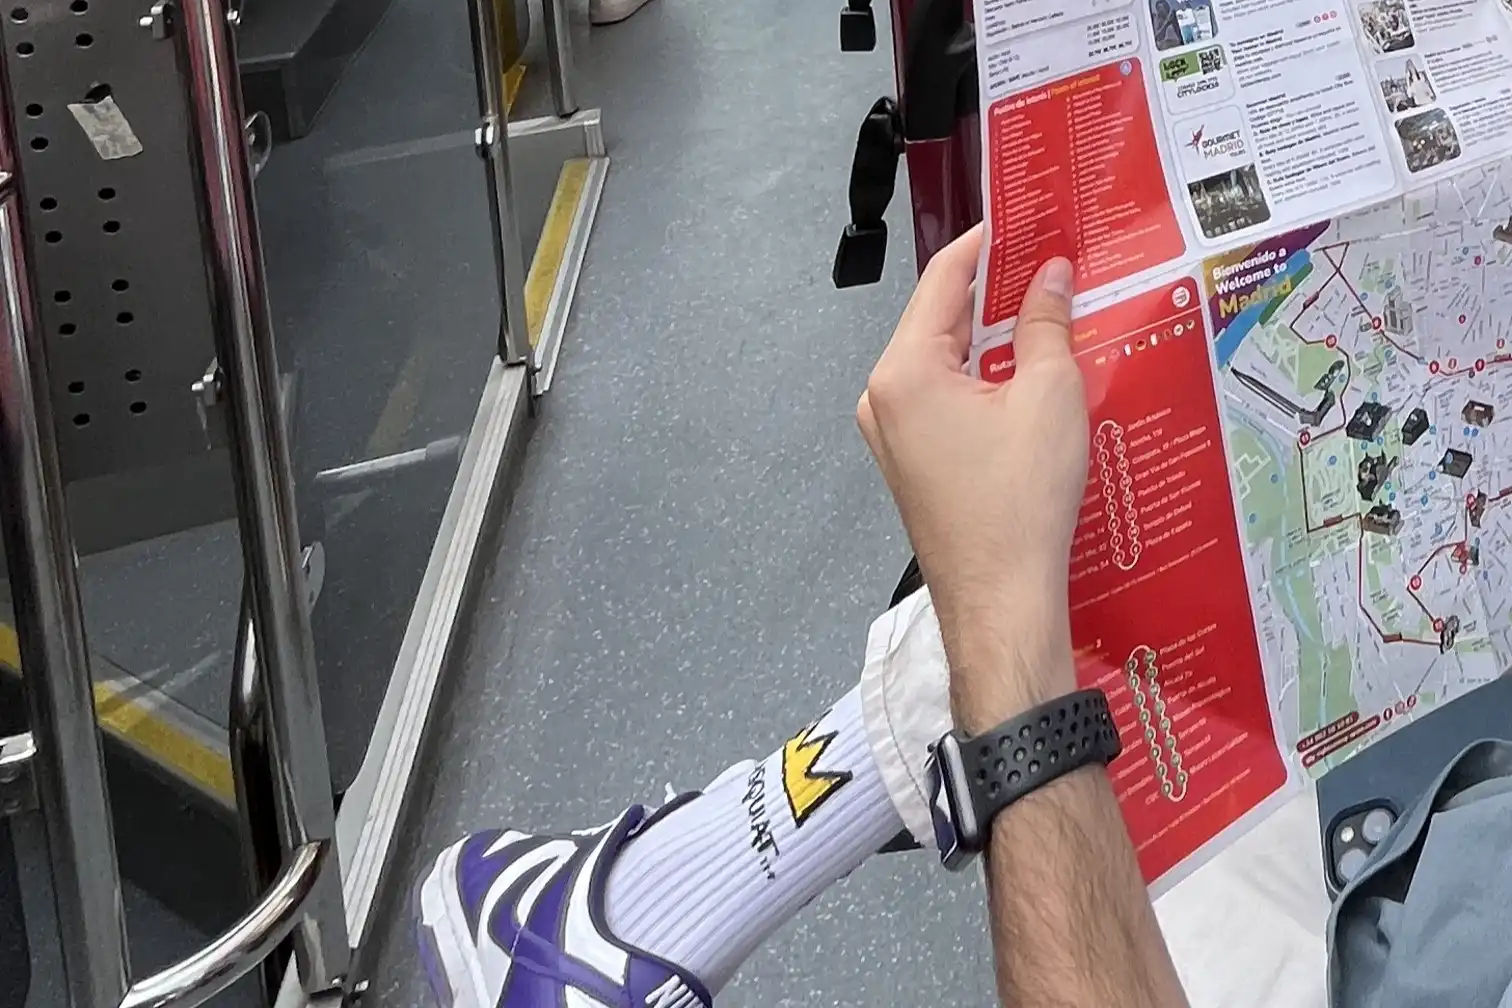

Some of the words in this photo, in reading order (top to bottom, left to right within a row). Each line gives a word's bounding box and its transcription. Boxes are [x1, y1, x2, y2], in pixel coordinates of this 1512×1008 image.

[1203, 140, 1244, 159] MADRID
[1212, 251, 1276, 280] Bienvenido
[1278, 247, 1286, 257] a
[1215, 268, 1271, 295] Welcome
[1273, 262, 1287, 273] to
[1219, 274, 1292, 318] Madrid
